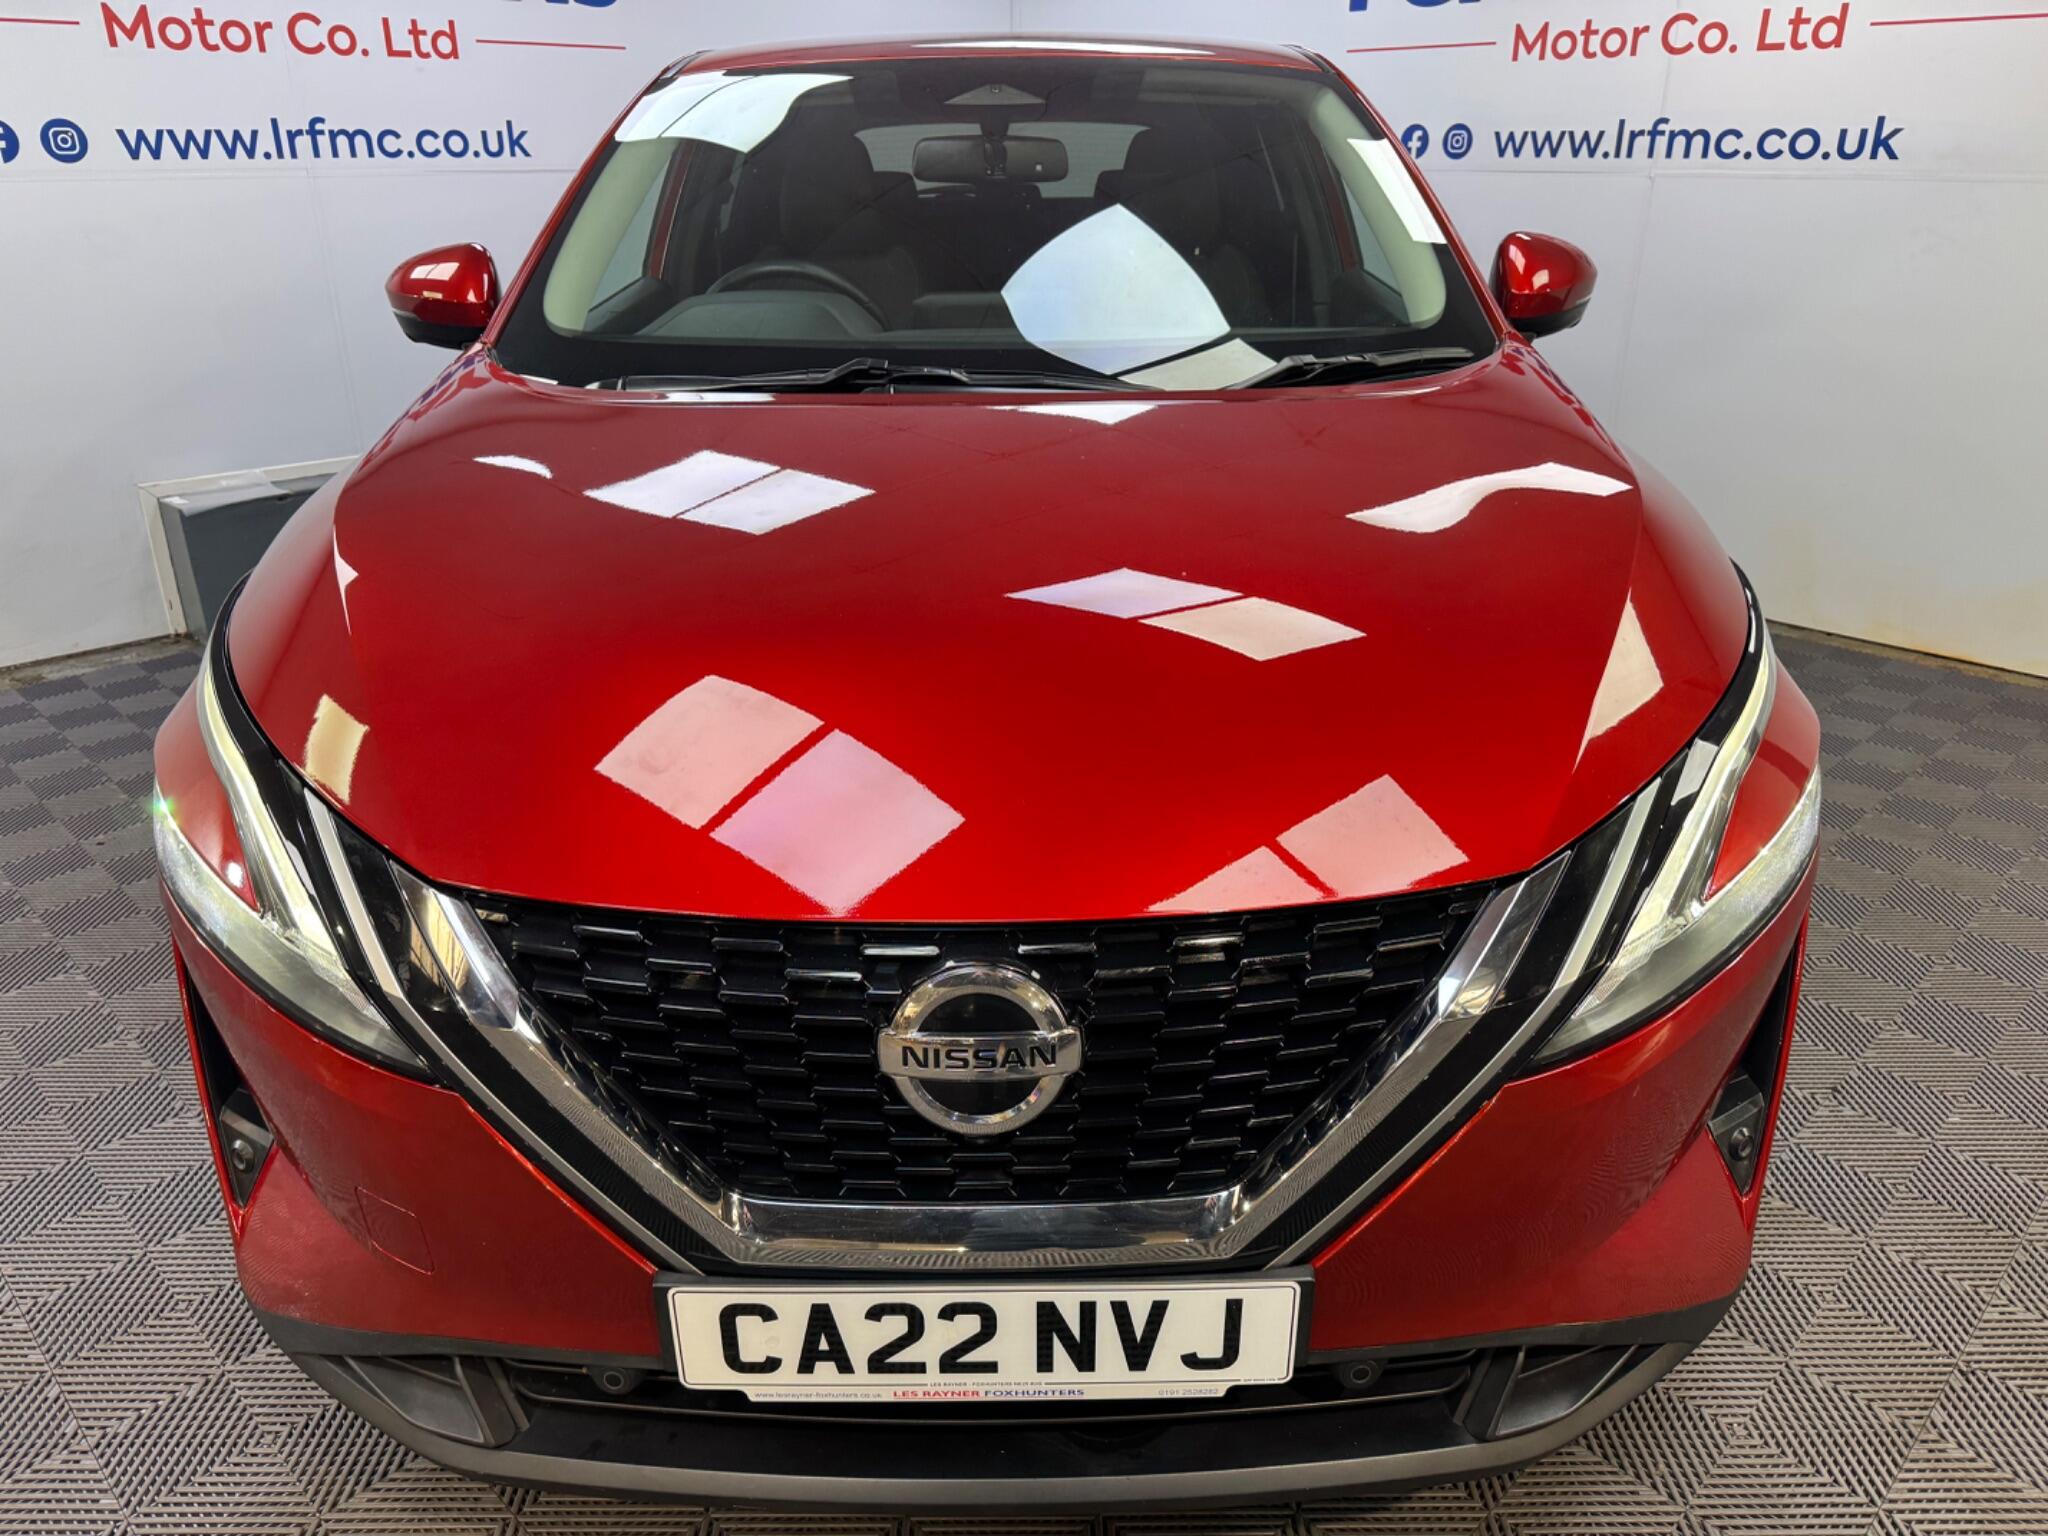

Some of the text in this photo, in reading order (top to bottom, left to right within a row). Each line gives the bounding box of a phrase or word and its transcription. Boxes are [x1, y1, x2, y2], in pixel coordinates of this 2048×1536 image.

[101, 3, 459, 60] Motor Co. Ltd
[1512, 3, 1850, 62] Motor Co. Ltd
[116, 117, 531, 160] www.lrfmc.co.uk
[1494, 116, 1904, 160] www.lrfmc.co.uk
[902, 1045, 1056, 1069] NISSAN
[718, 1299, 1243, 1374] CA22 NVJ
[893, 1389, 1085, 1398] LES RAYNER FOXHUNTERS
